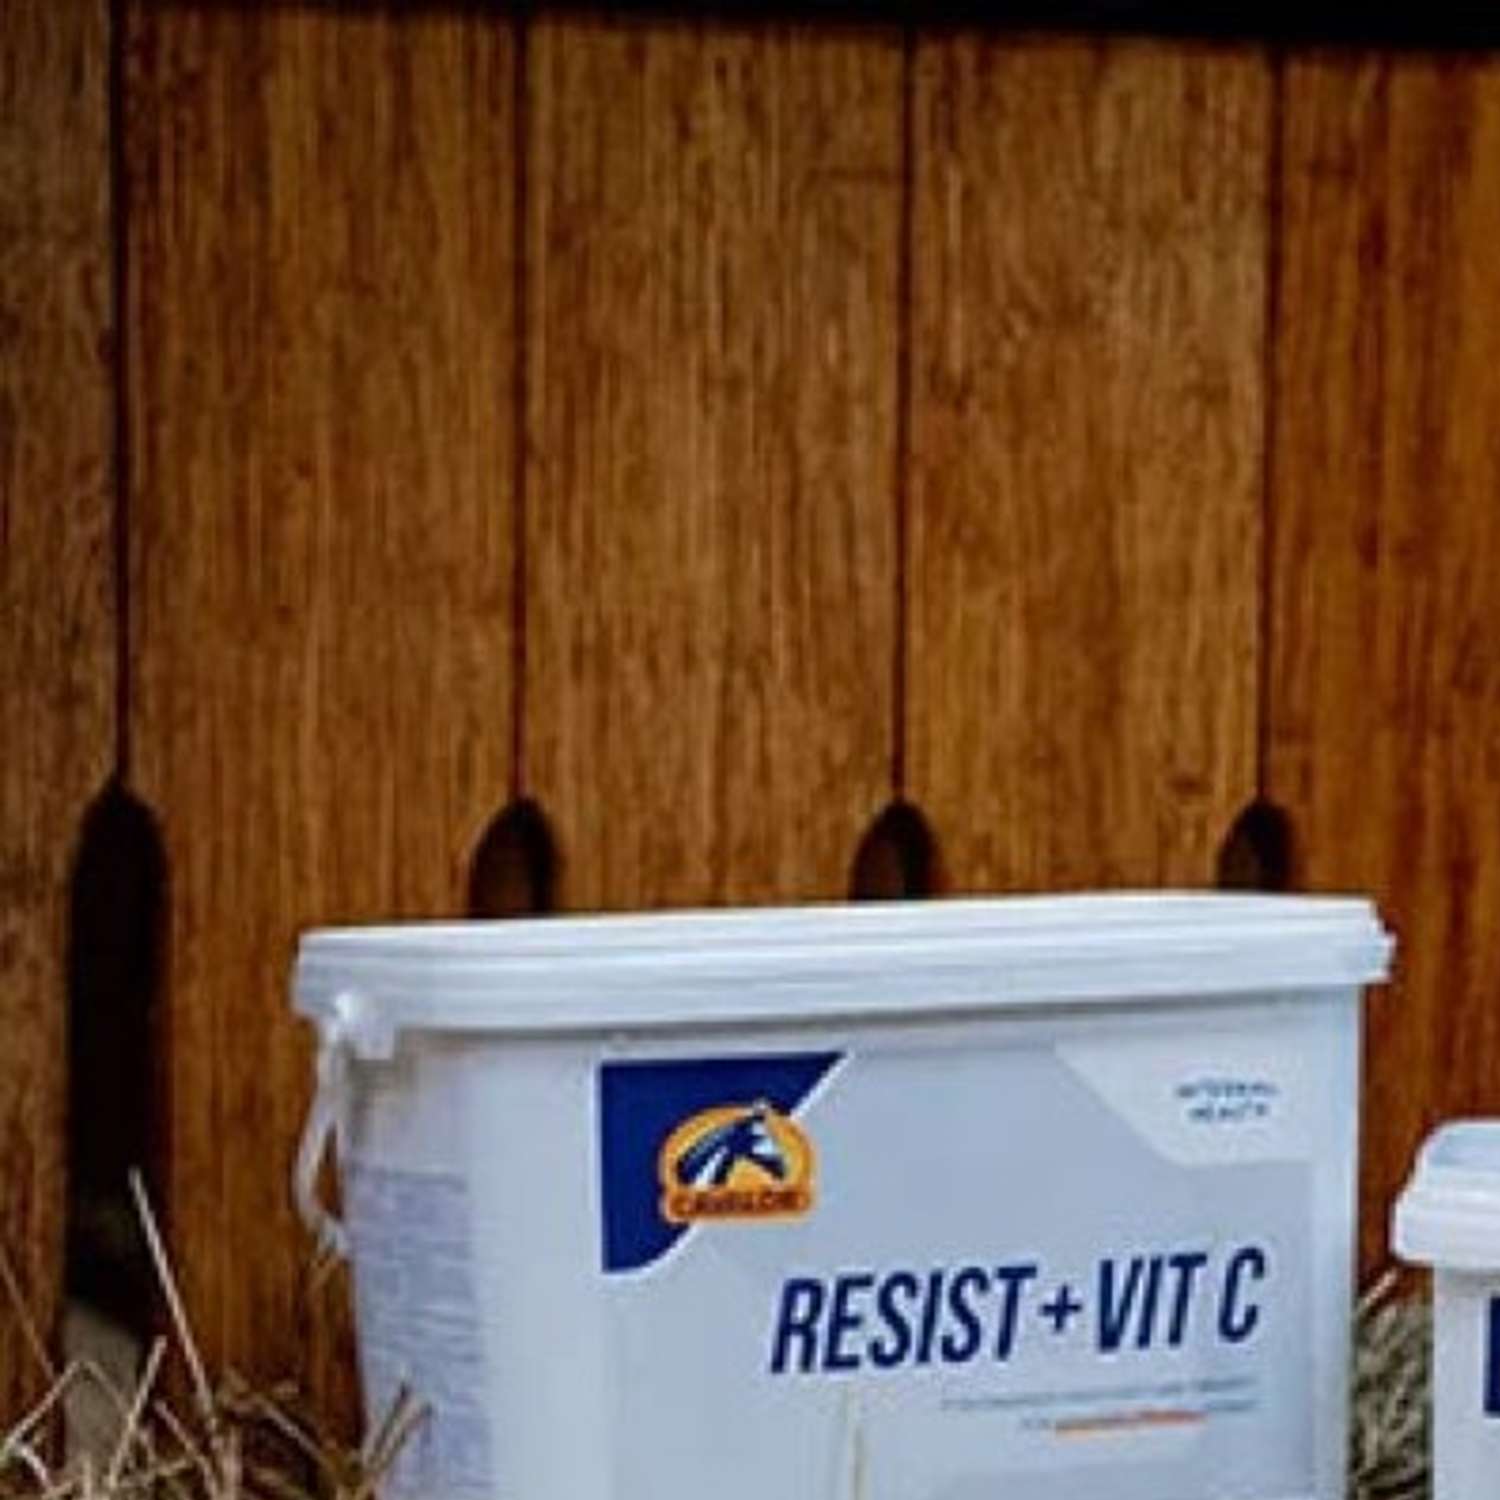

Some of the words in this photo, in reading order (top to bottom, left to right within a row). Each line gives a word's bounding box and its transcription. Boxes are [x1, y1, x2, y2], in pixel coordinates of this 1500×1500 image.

[770, 1266, 1038, 1375] RESIST
[1095, 1251, 1207, 1352] VIT
[1218, 1245, 1267, 1344] C
